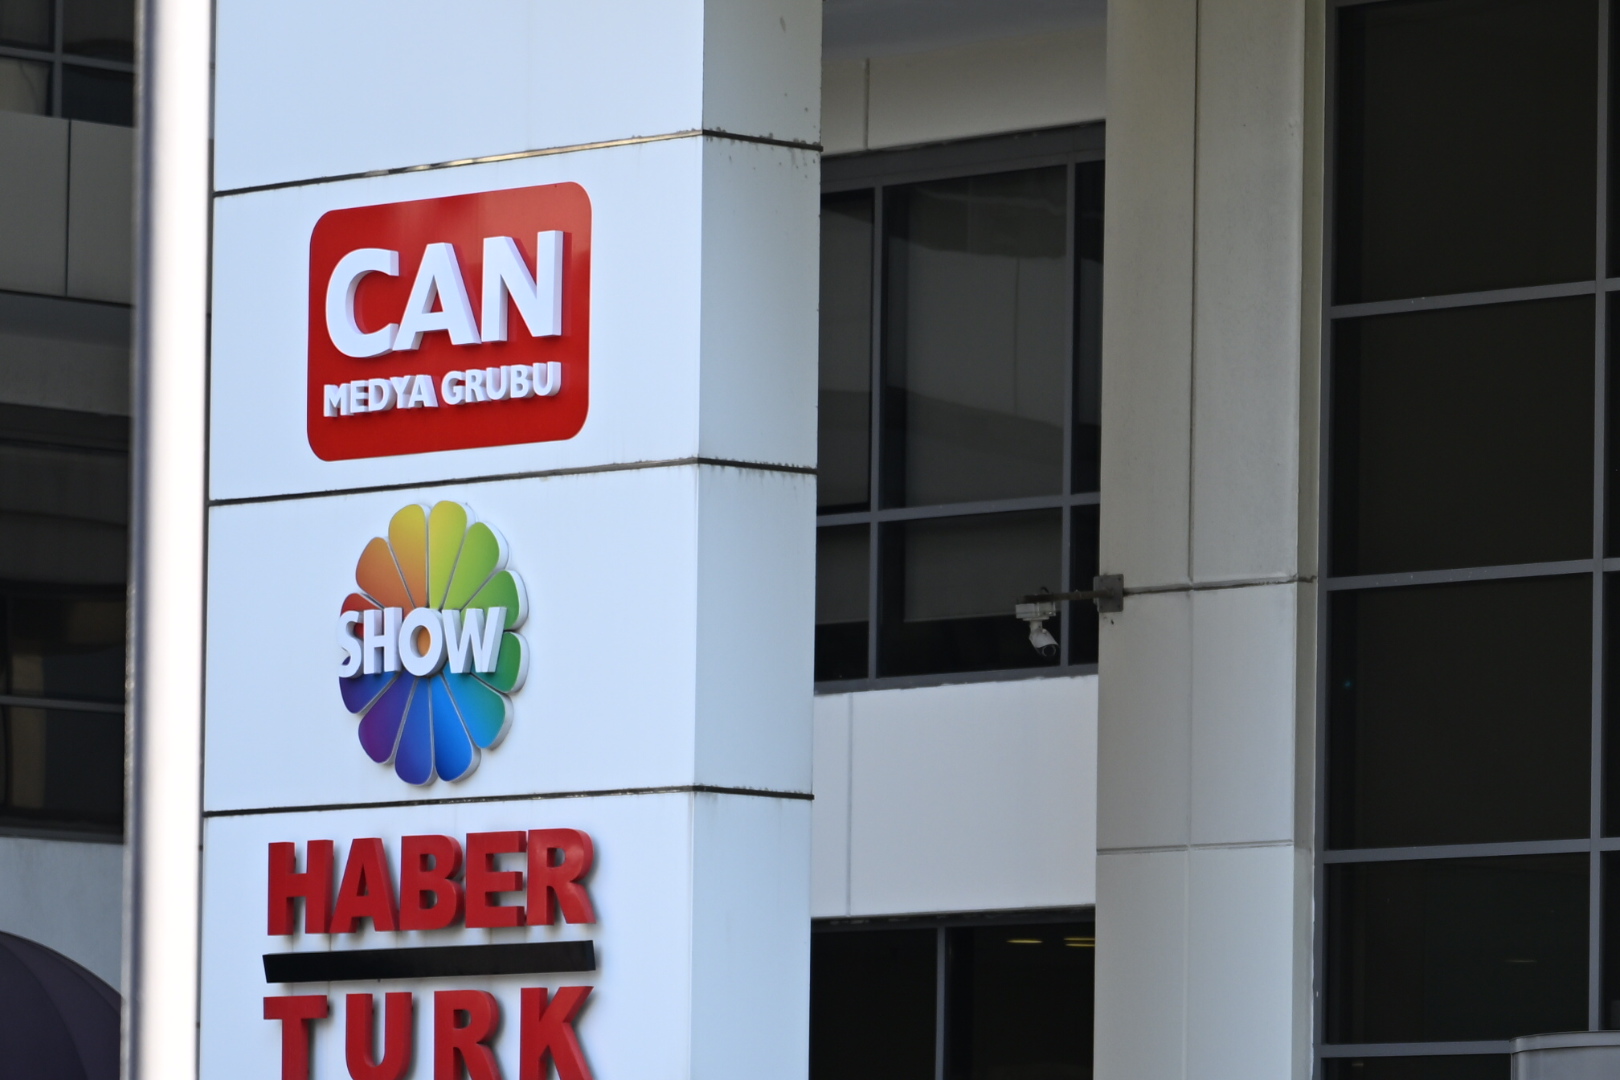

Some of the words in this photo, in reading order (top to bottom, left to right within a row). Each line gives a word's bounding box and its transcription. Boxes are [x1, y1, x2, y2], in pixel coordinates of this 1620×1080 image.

[326, 230, 563, 358] CAN
[324, 374, 438, 417] MEDYA
[442, 361, 561, 405] GRUBU
[338, 607, 507, 678] SHOW
[267, 828, 596, 935] HABER
